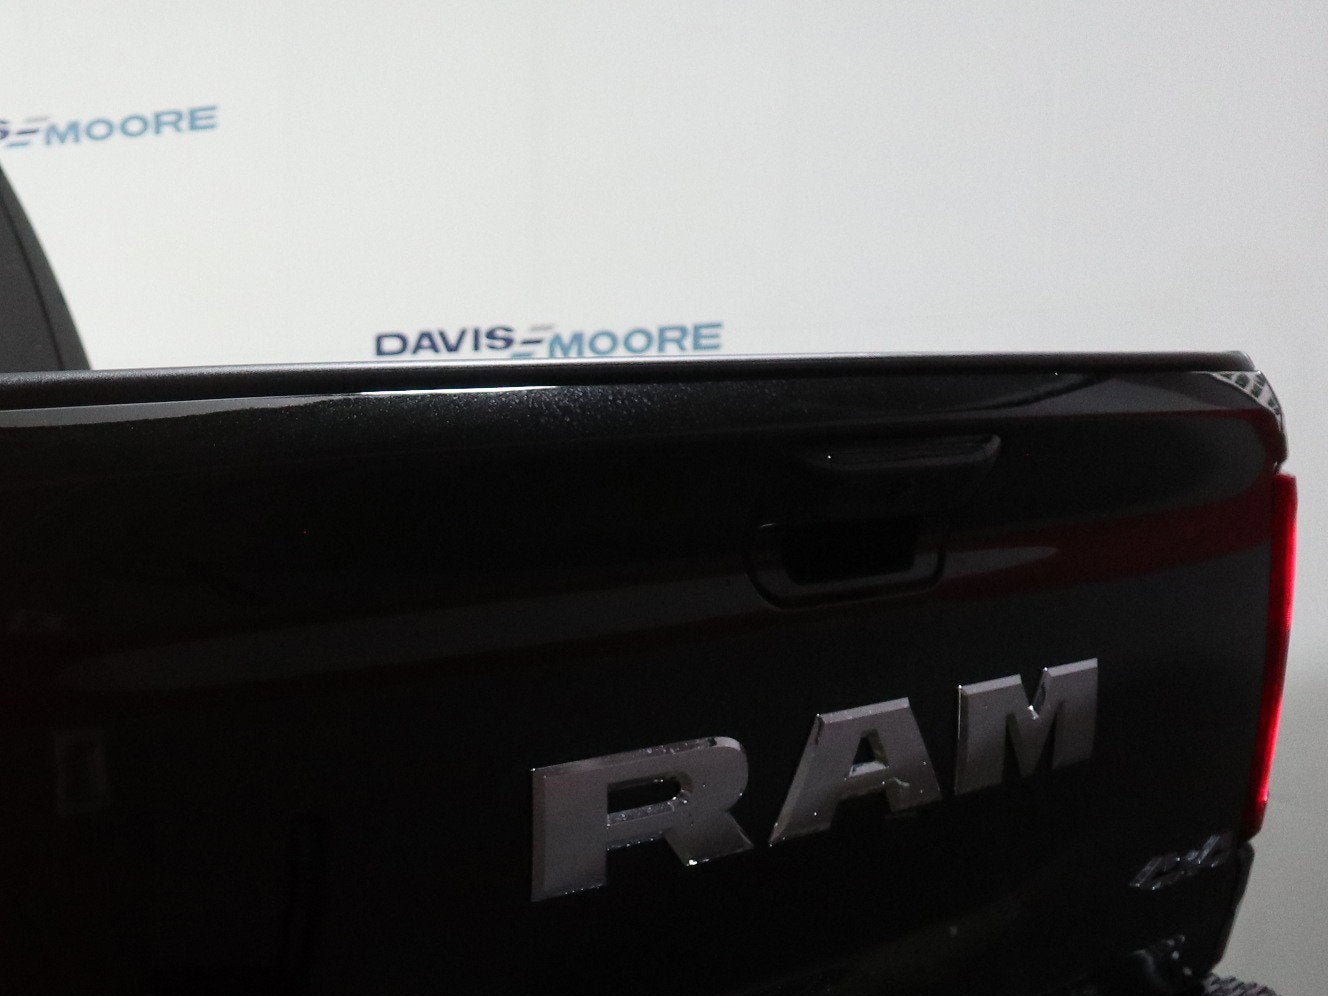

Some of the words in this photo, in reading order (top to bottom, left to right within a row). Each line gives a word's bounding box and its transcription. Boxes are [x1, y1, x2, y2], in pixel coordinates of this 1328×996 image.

[44, 104, 218, 146] MOORE
[375, 325, 514, 357] DAVIS
[548, 322, 723, 358] MOORE
[530, 658, 1099, 902] RAM
